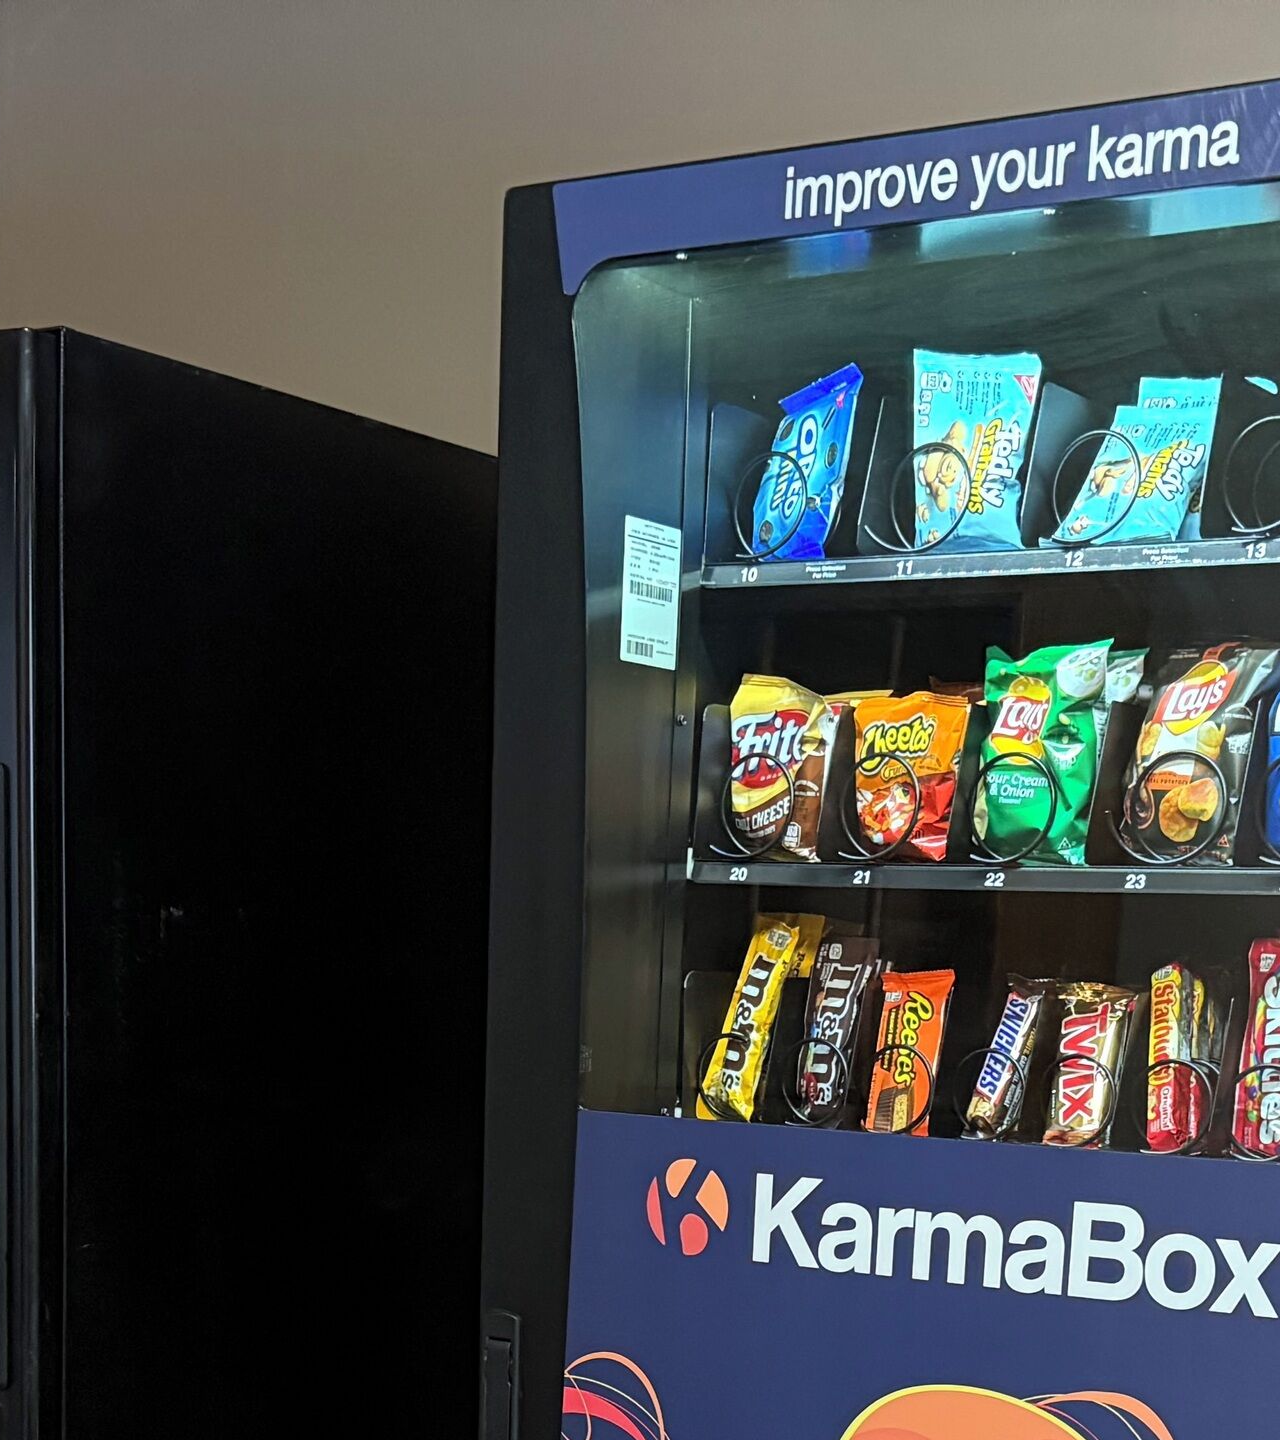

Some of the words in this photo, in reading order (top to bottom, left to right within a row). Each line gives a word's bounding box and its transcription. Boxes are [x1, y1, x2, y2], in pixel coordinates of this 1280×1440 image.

[784, 158, 958, 226] improve
[970, 140, 1075, 210] your
[1087, 119, 1240, 182] karma
[782, 414, 818, 518] OREO
[967, 418, 1003, 515] Grahams
[981, 420, 1021, 508] Teddy
[1065, 551, 1084, 567] 12
[1245, 542, 1268, 559] 13
[741, 567, 758, 582] 10
[896, 560, 913, 576] 11
[1162, 675, 1227, 723] Lay's
[860, 713, 935, 773] Cheetos
[986, 772, 1009, 784] Sour
[1011, 774, 1048, 788] Cream
[990, 785, 998, 795] &
[1000, 785, 1035, 798] Onion
[752, 796, 790, 829] CHEESE
[729, 867, 748, 882] 20
[853, 870, 871, 885] 21
[985, 872, 1005, 887] 22
[1124, 875, 1146, 889] 23
[893, 991, 934, 1086] Reese's
[979, 998, 1029, 1095] SNICKERS
[1062, 1002, 1111, 1124] TWIX
